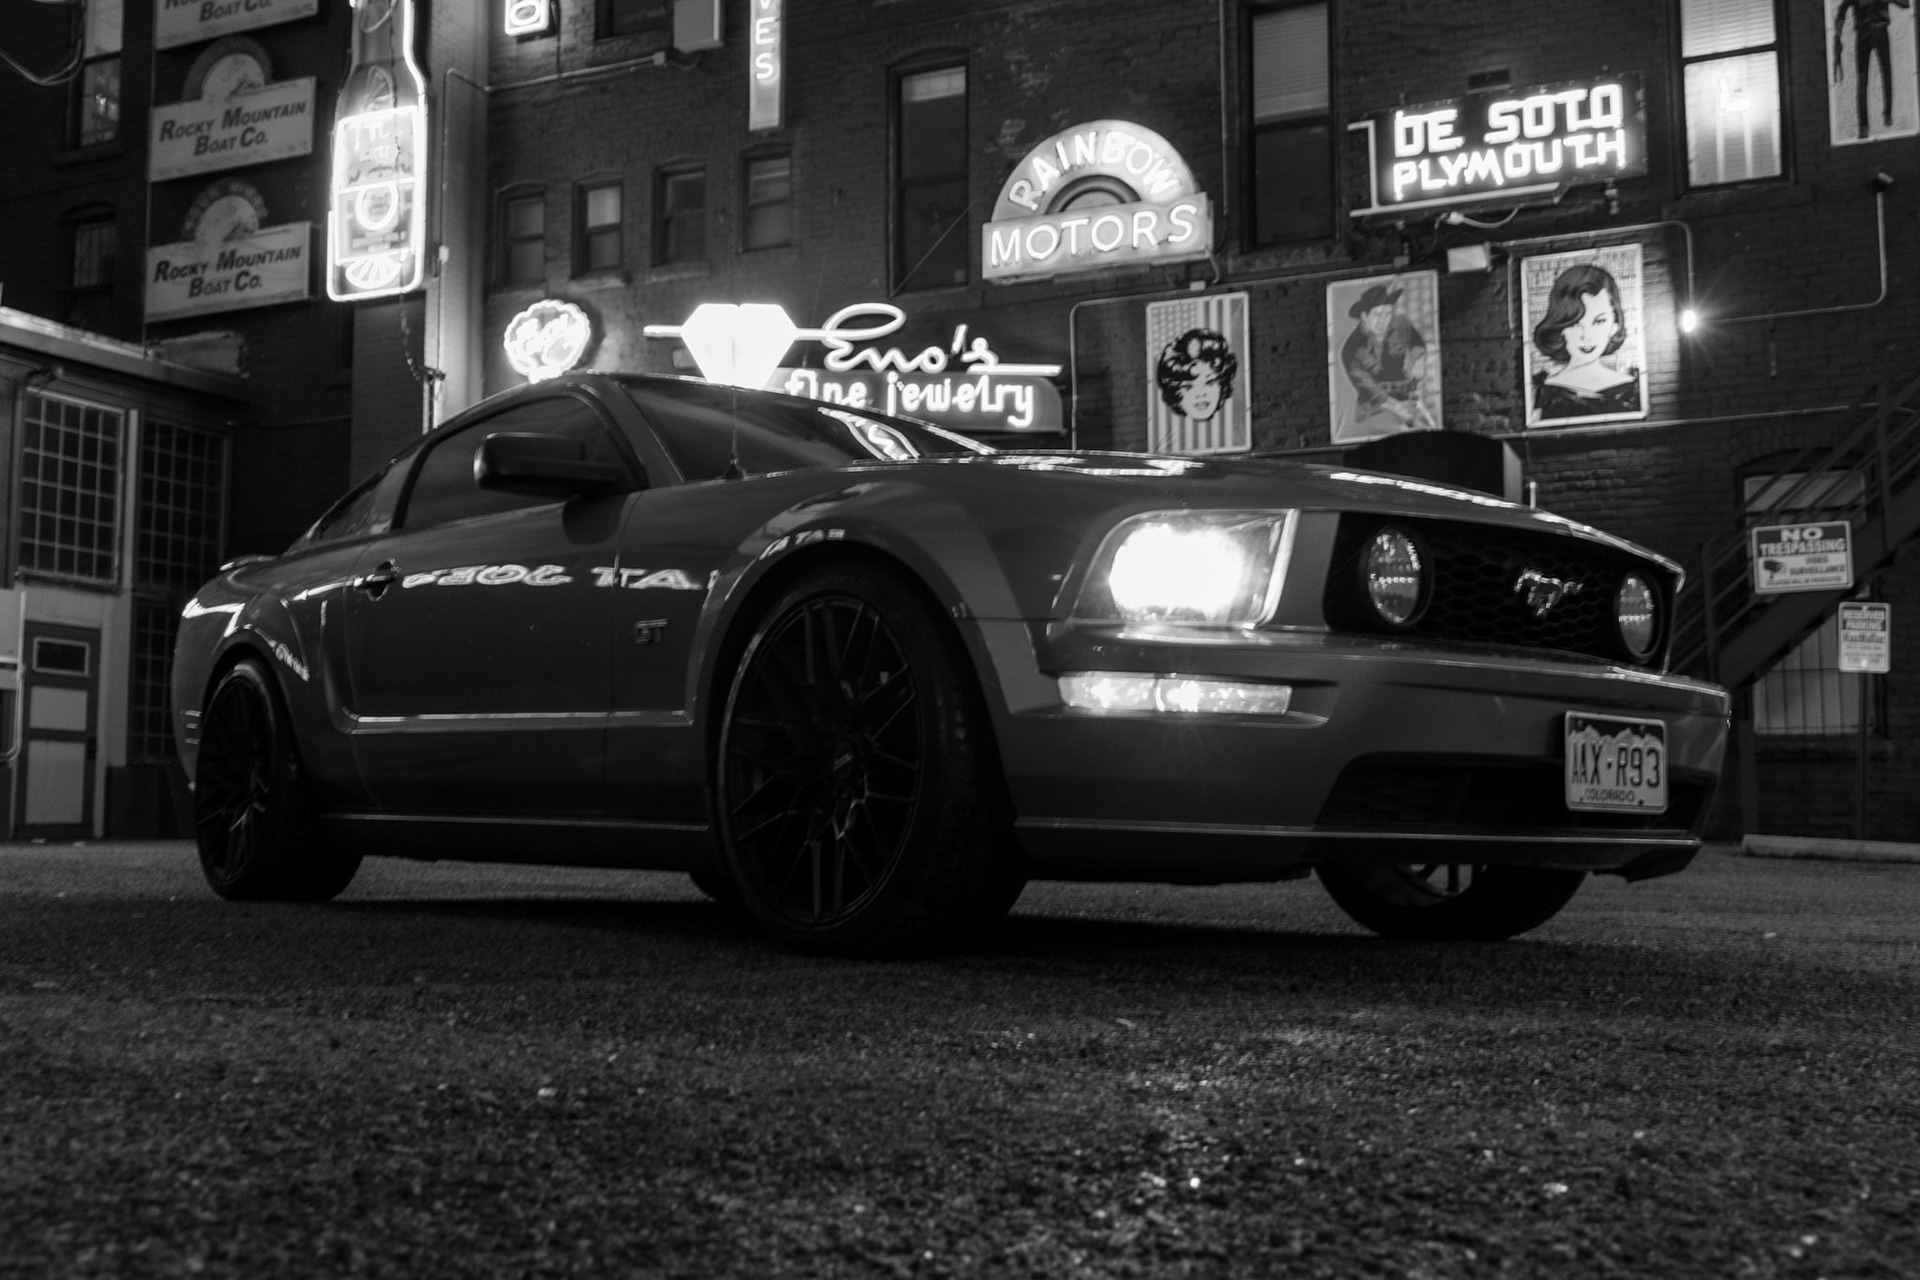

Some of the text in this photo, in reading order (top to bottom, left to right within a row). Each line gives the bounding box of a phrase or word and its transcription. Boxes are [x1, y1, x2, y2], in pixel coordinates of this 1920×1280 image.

[1393, 83, 1625, 158] DE SOTO
[1008, 131, 1180, 211] RAINBOW
[1392, 128, 1627, 201] PLYMOUTH
[991, 203, 1197, 266] MOTORS
[821, 302, 1000, 374] Eno's
[784, 368, 1035, 428] fine jewelry
[1759, 537, 1846, 556] TRESPASSING
[1780, 526, 1824, 543] NO
